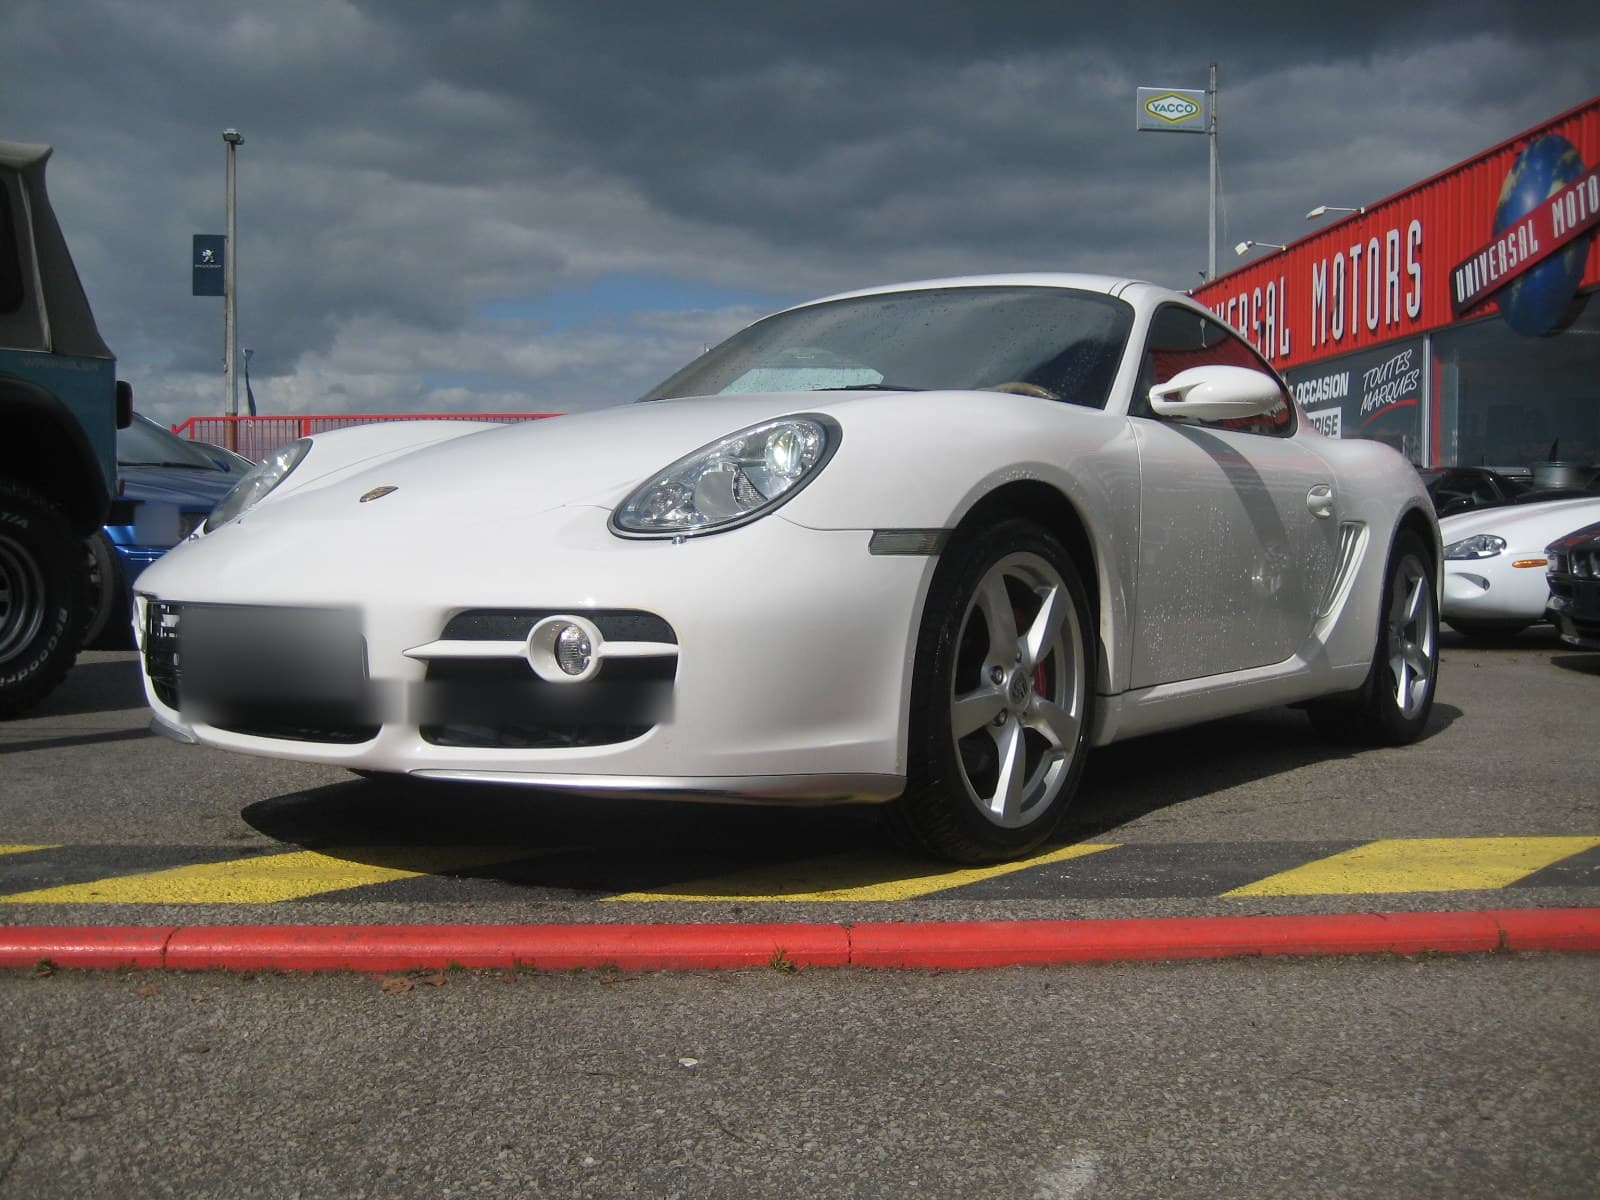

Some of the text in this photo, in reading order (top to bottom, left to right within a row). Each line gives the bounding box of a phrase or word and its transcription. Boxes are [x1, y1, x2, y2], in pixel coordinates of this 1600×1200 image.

[1152, 103, 1194, 113] YACCO
[1456, 219, 1539, 303] UNIVERSAL
[1209, 219, 1422, 360] RSAL MOTORS
[1296, 371, 1349, 405] OCCASION
[1360, 369, 1420, 416] MARQUES
[1363, 349, 1412, 393] TOUTES
